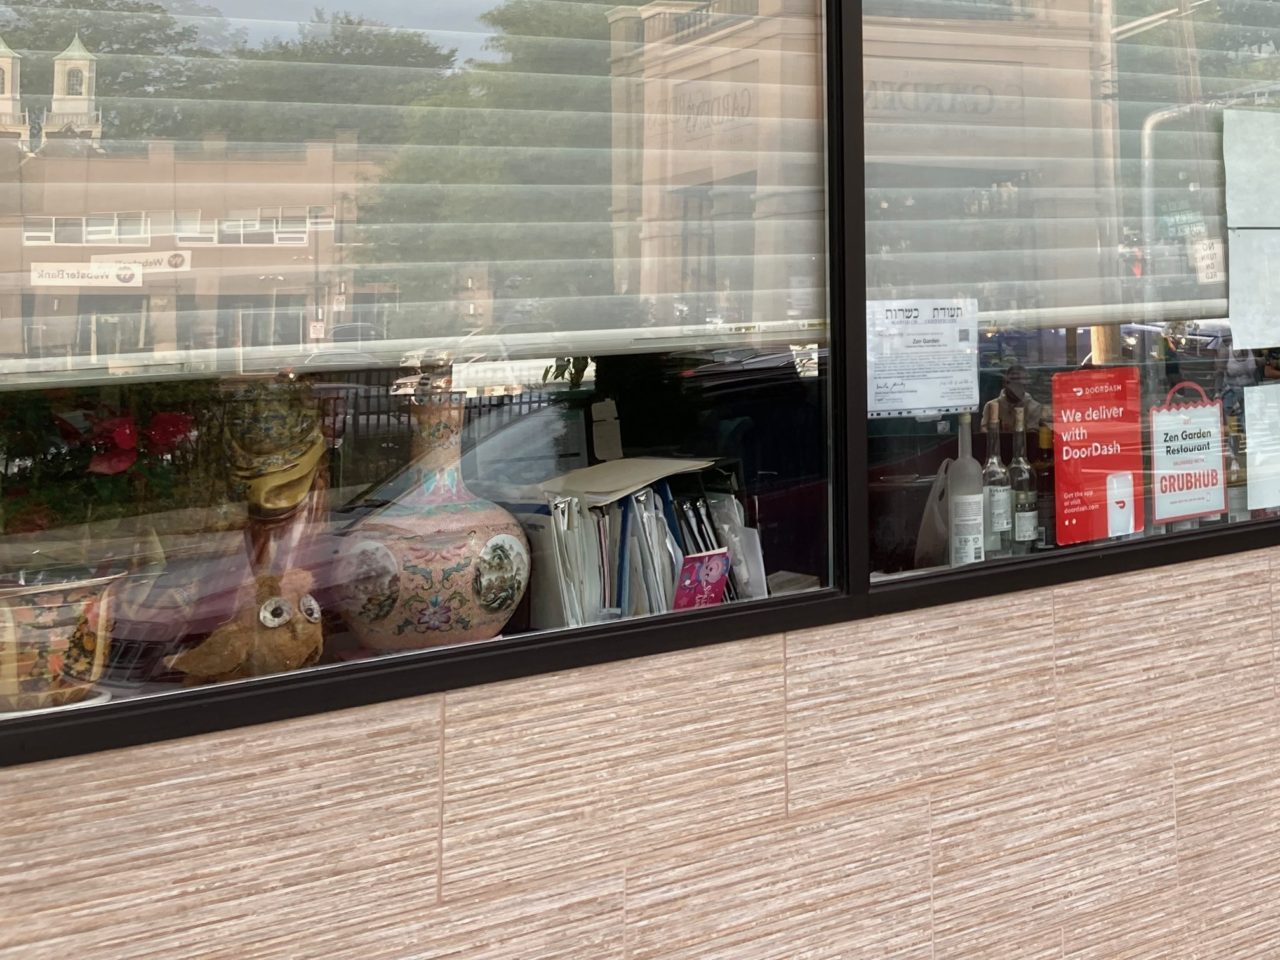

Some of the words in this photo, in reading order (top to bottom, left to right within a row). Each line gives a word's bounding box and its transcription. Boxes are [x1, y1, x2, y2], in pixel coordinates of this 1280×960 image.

[1085, 384, 1122, 394] DOORDASH
[1061, 409, 1082, 423] We
[1084, 406, 1124, 421] deliver
[1061, 426, 1088, 441] with
[1163, 432, 1179, 442] Zen
[1181, 429, 1212, 440] Garden
[1062, 441, 1121, 460] DoorDash
[1165, 441, 1211, 455] Restaurant
[1160, 469, 1219, 494] GRUBHUB
